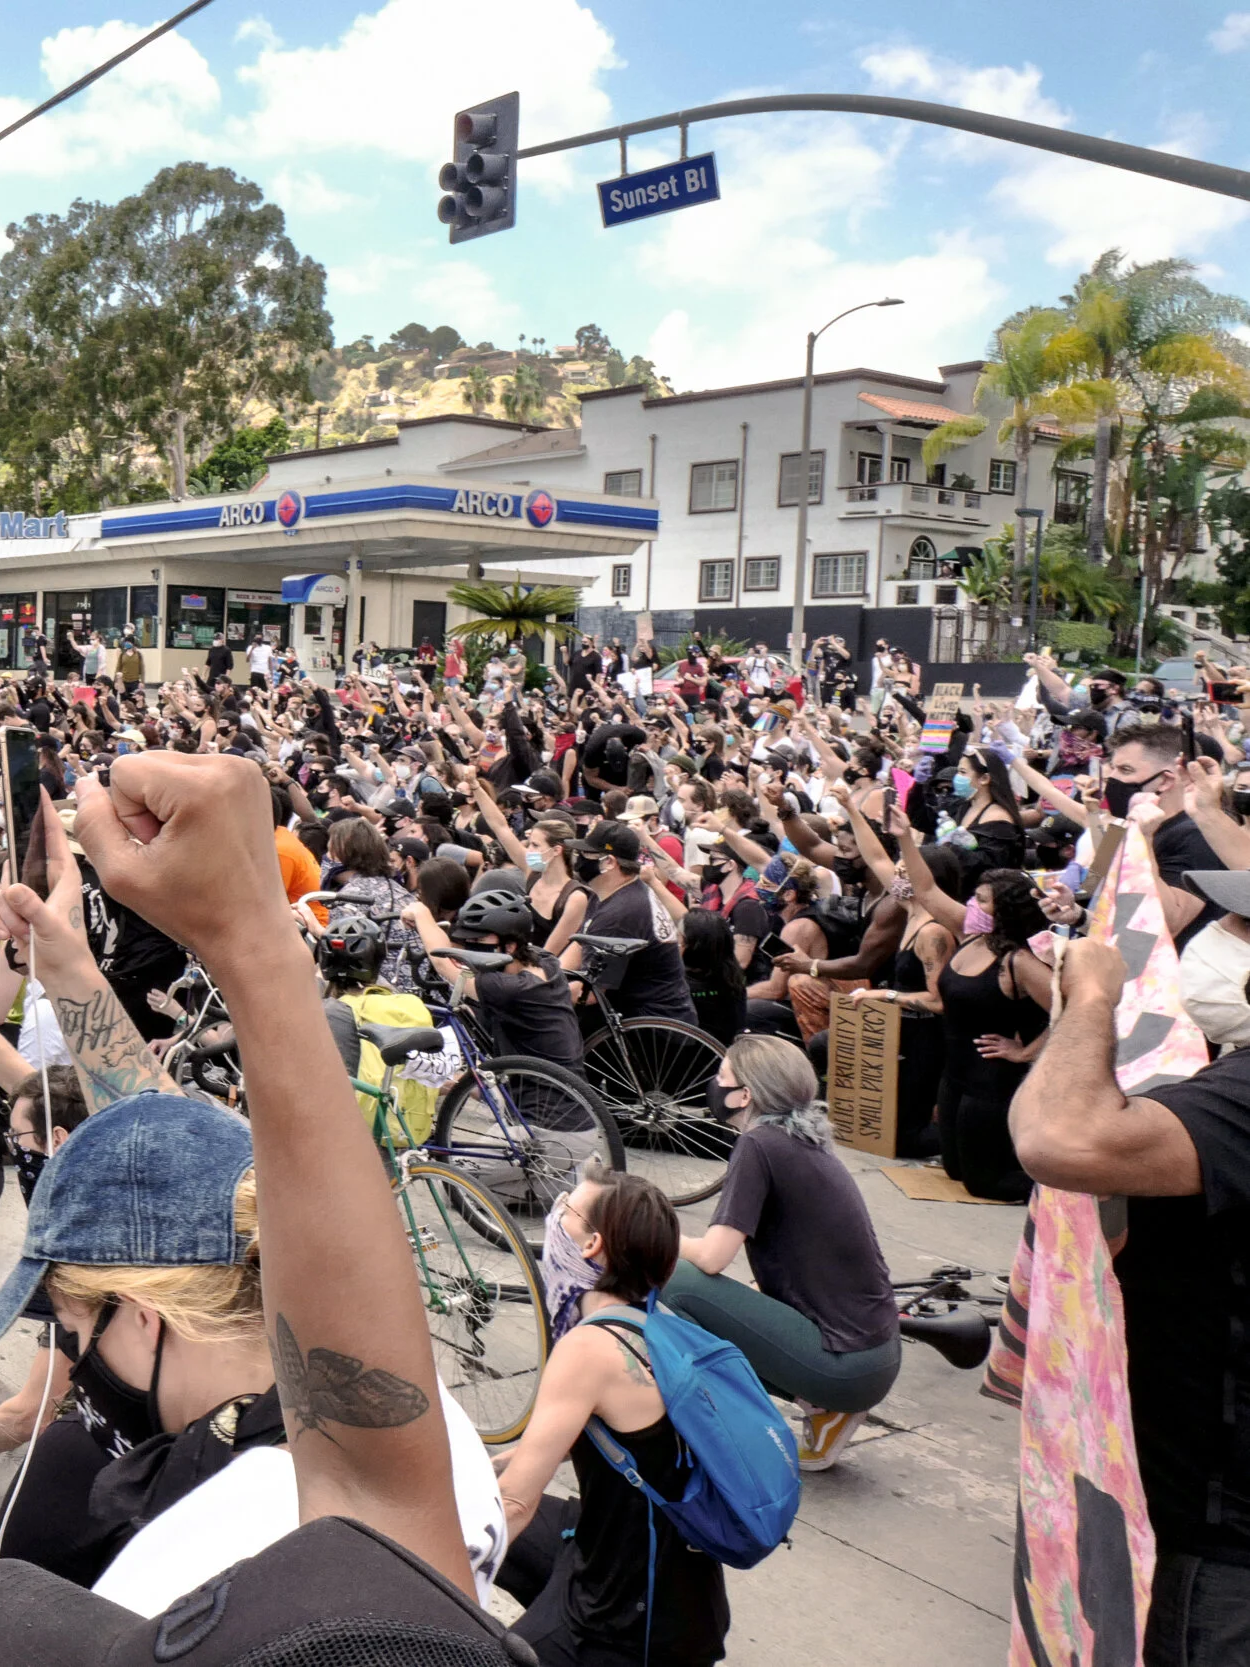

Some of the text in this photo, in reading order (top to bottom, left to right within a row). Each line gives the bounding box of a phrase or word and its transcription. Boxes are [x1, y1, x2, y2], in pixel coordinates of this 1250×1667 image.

[610, 166, 707, 213] Sunset Bl
[219, 501, 265, 527] ARCO
[450, 489, 514, 517] ARCO
[0, 510, 68, 539] Mart
[837, 997, 857, 1012] IS
[835, 1015, 856, 1089] BRUTALITY
[860, 1059, 884, 1092] DICK
[859, 1095, 884, 1140] SMALL
